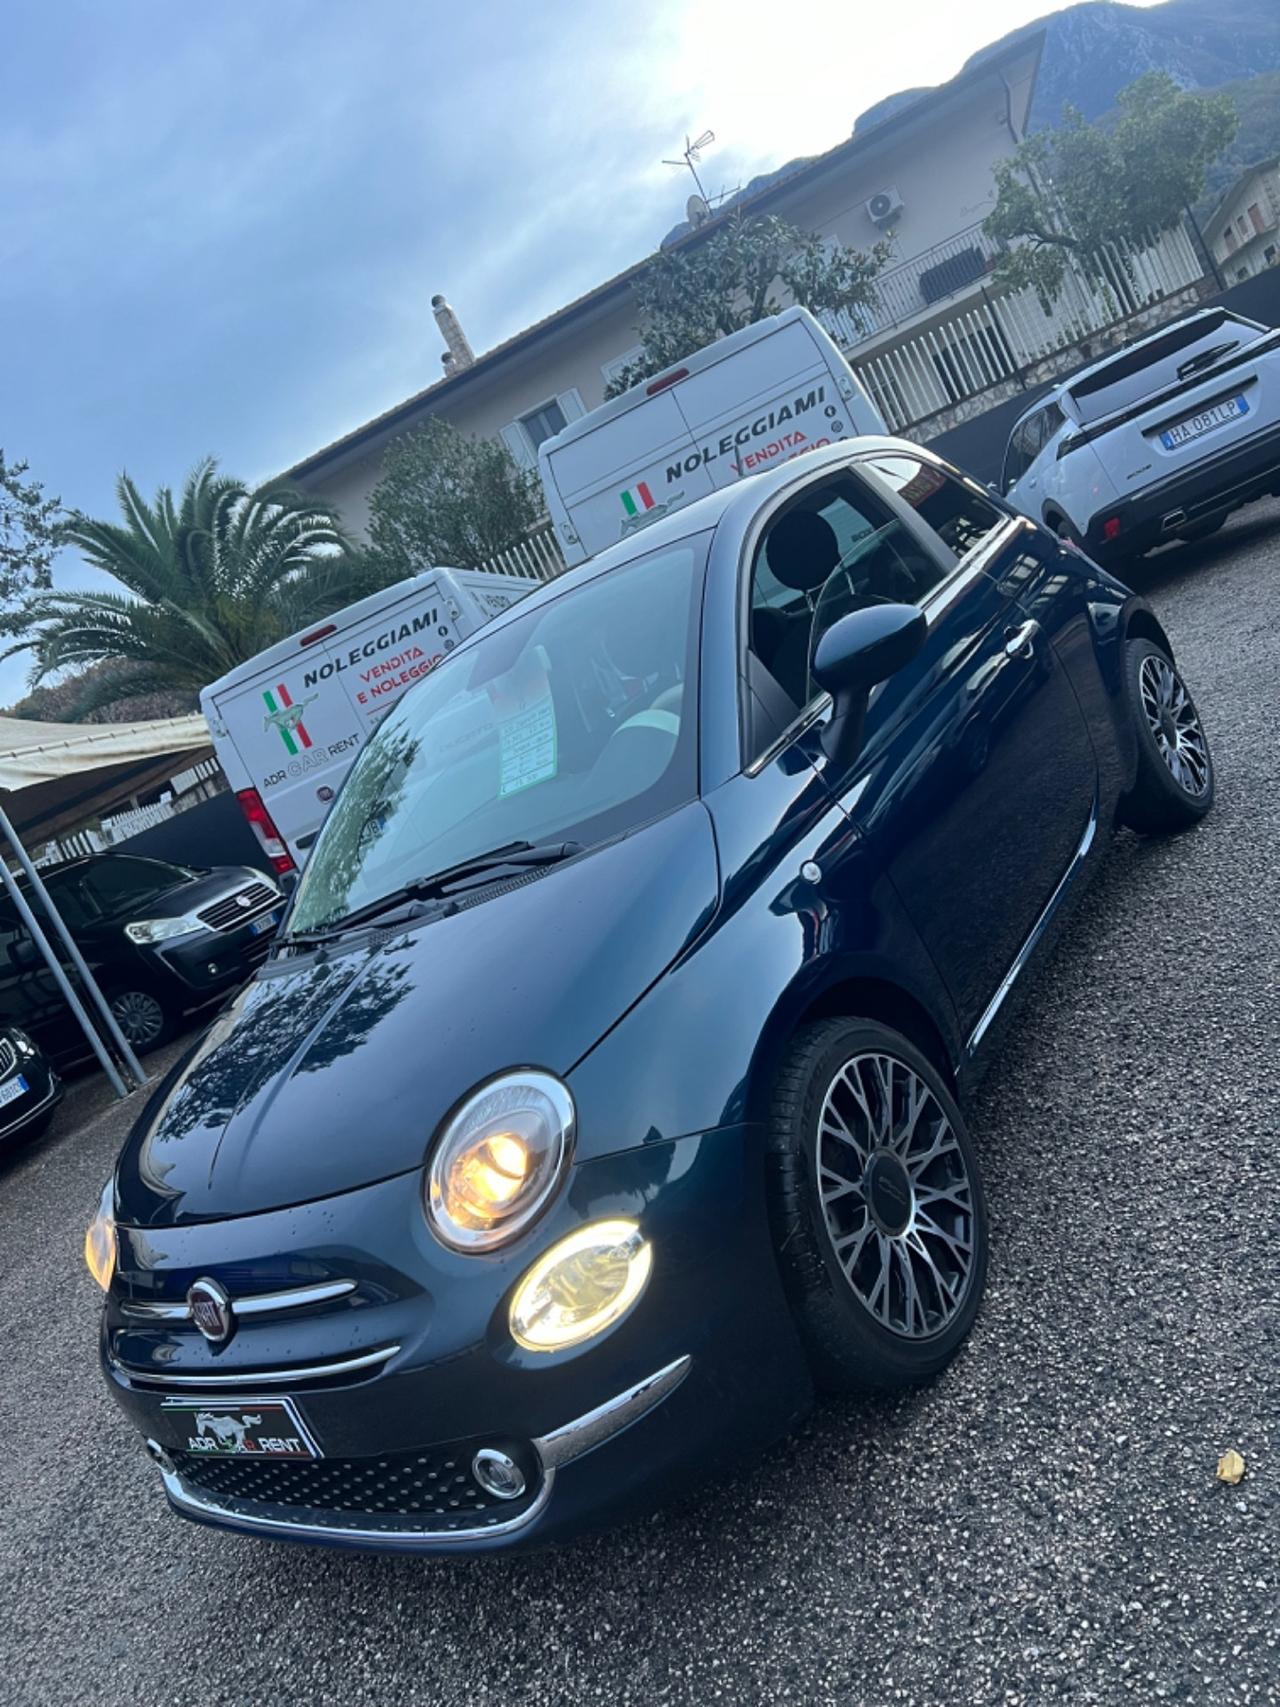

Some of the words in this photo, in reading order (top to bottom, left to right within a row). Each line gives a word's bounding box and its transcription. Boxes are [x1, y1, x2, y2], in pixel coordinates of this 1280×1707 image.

[666, 386, 825, 483] NOLEGGIAMI
[304, 608, 438, 688] NOLEGGIAMI
[360, 647, 424, 683] VENDITA
[356, 692, 368, 704] E
[370, 654, 444, 698] NOLEGGIO
[263, 769, 287, 788] ADR
[287, 747, 330, 777] CAR
[328, 733, 360, 756] RENT
[189, 1437, 219, 1450] ADR
[258, 1438, 301, 1451] RENT
